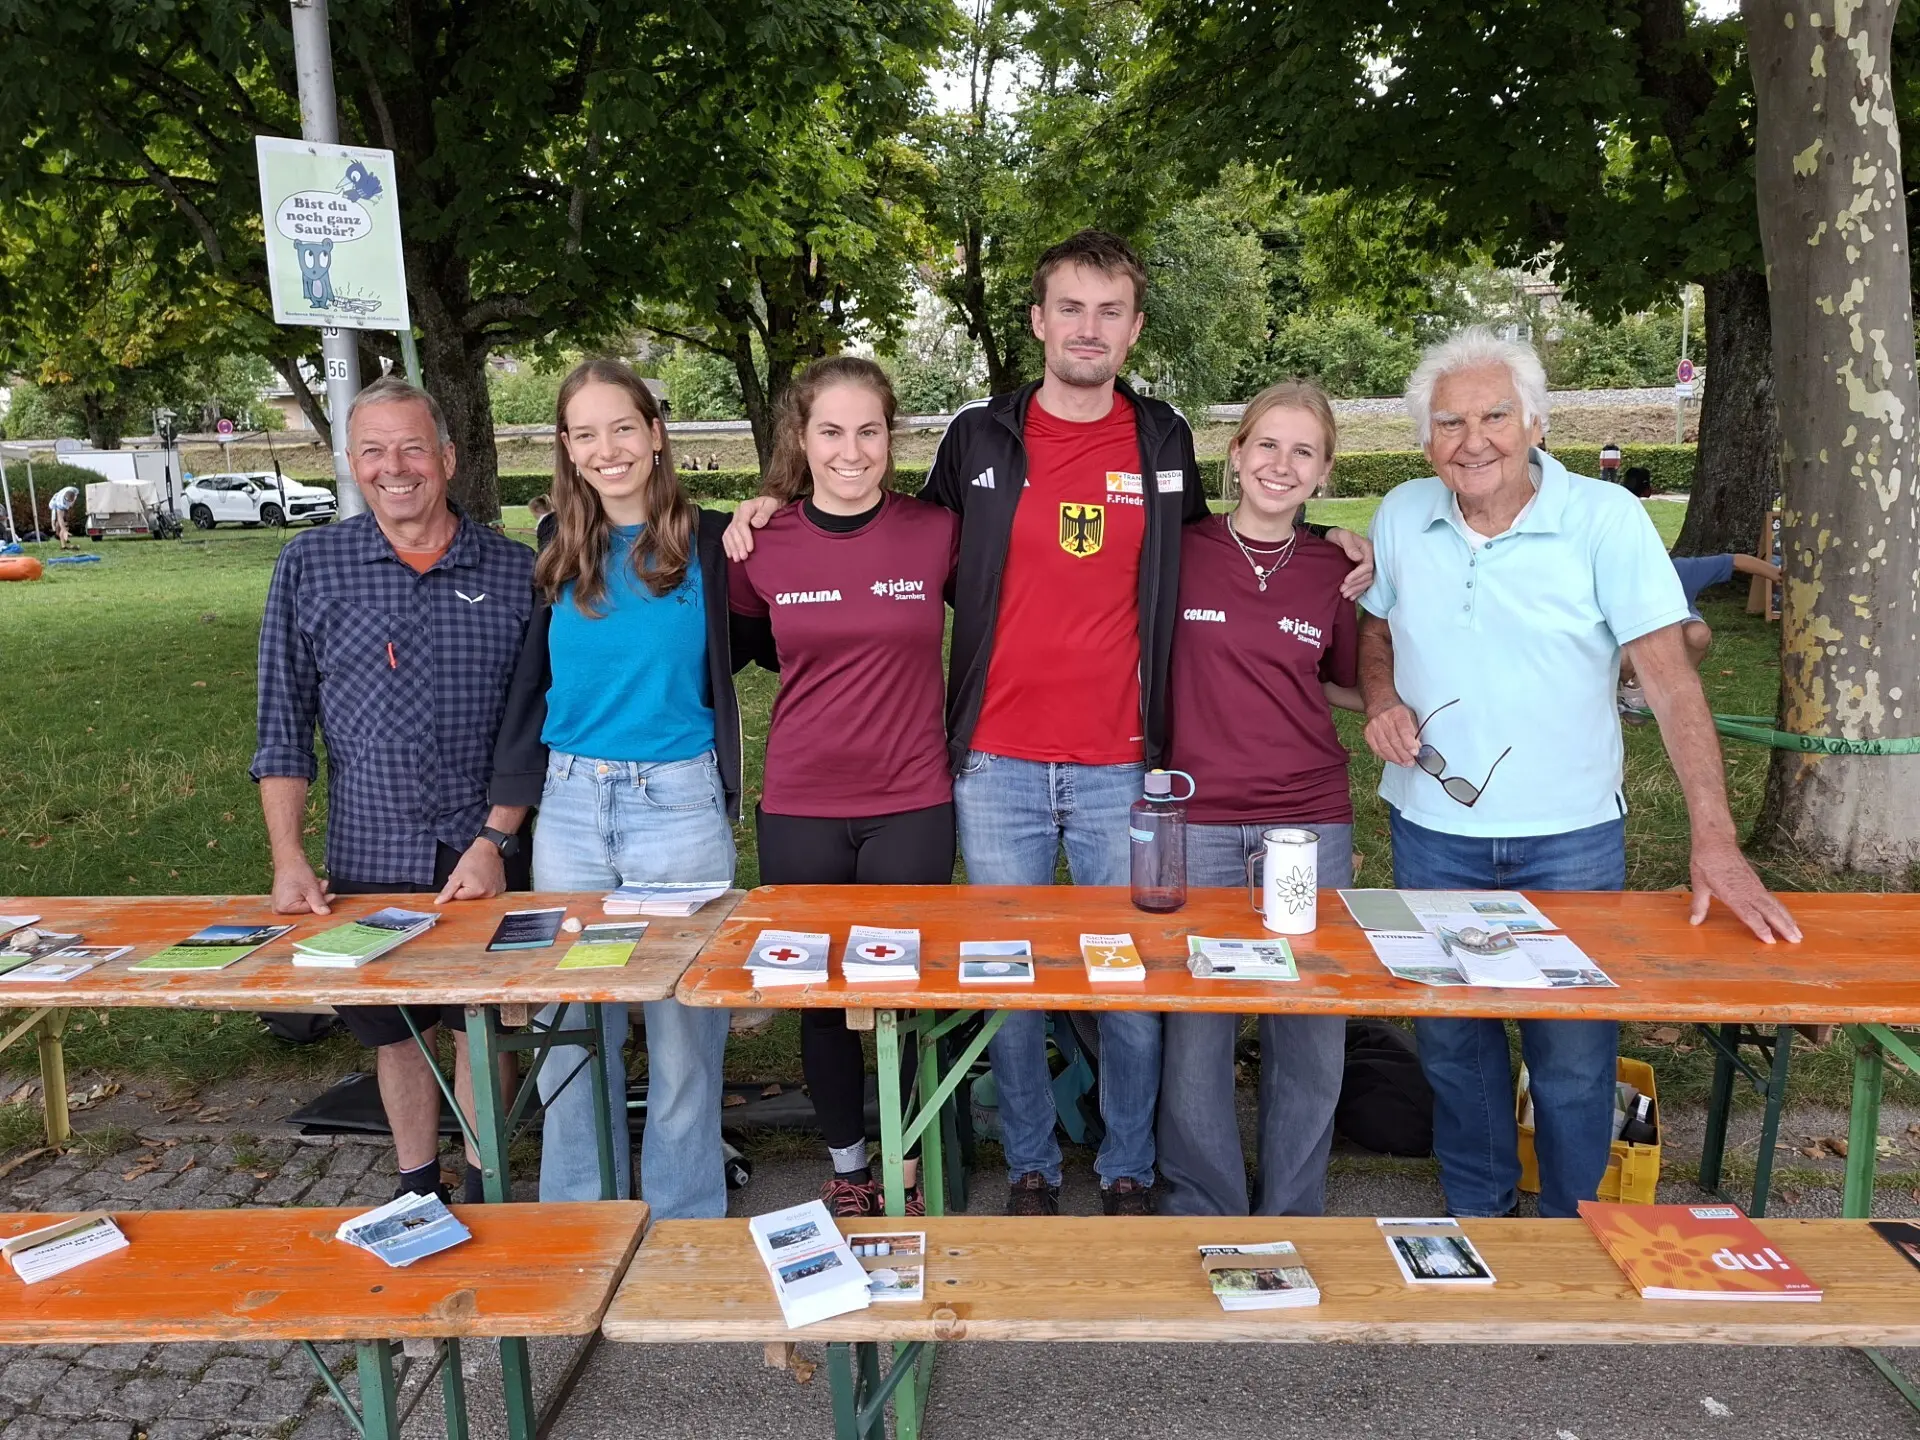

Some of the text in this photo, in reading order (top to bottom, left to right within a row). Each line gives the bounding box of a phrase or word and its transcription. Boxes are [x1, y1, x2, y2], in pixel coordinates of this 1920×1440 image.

[294, 197, 347, 211] Bist du
[286, 212, 361, 225] noch ganz
[294, 223, 355, 237] Saubär?
[329, 361, 346, 377] 56
[888, 578, 924, 596] jdav
[895, 593, 925, 601] Starnberg
[1292, 618, 1322, 639] jdav
[1297, 634, 1321, 648] Starnberg
[1711, 1248, 1791, 1270] du!
